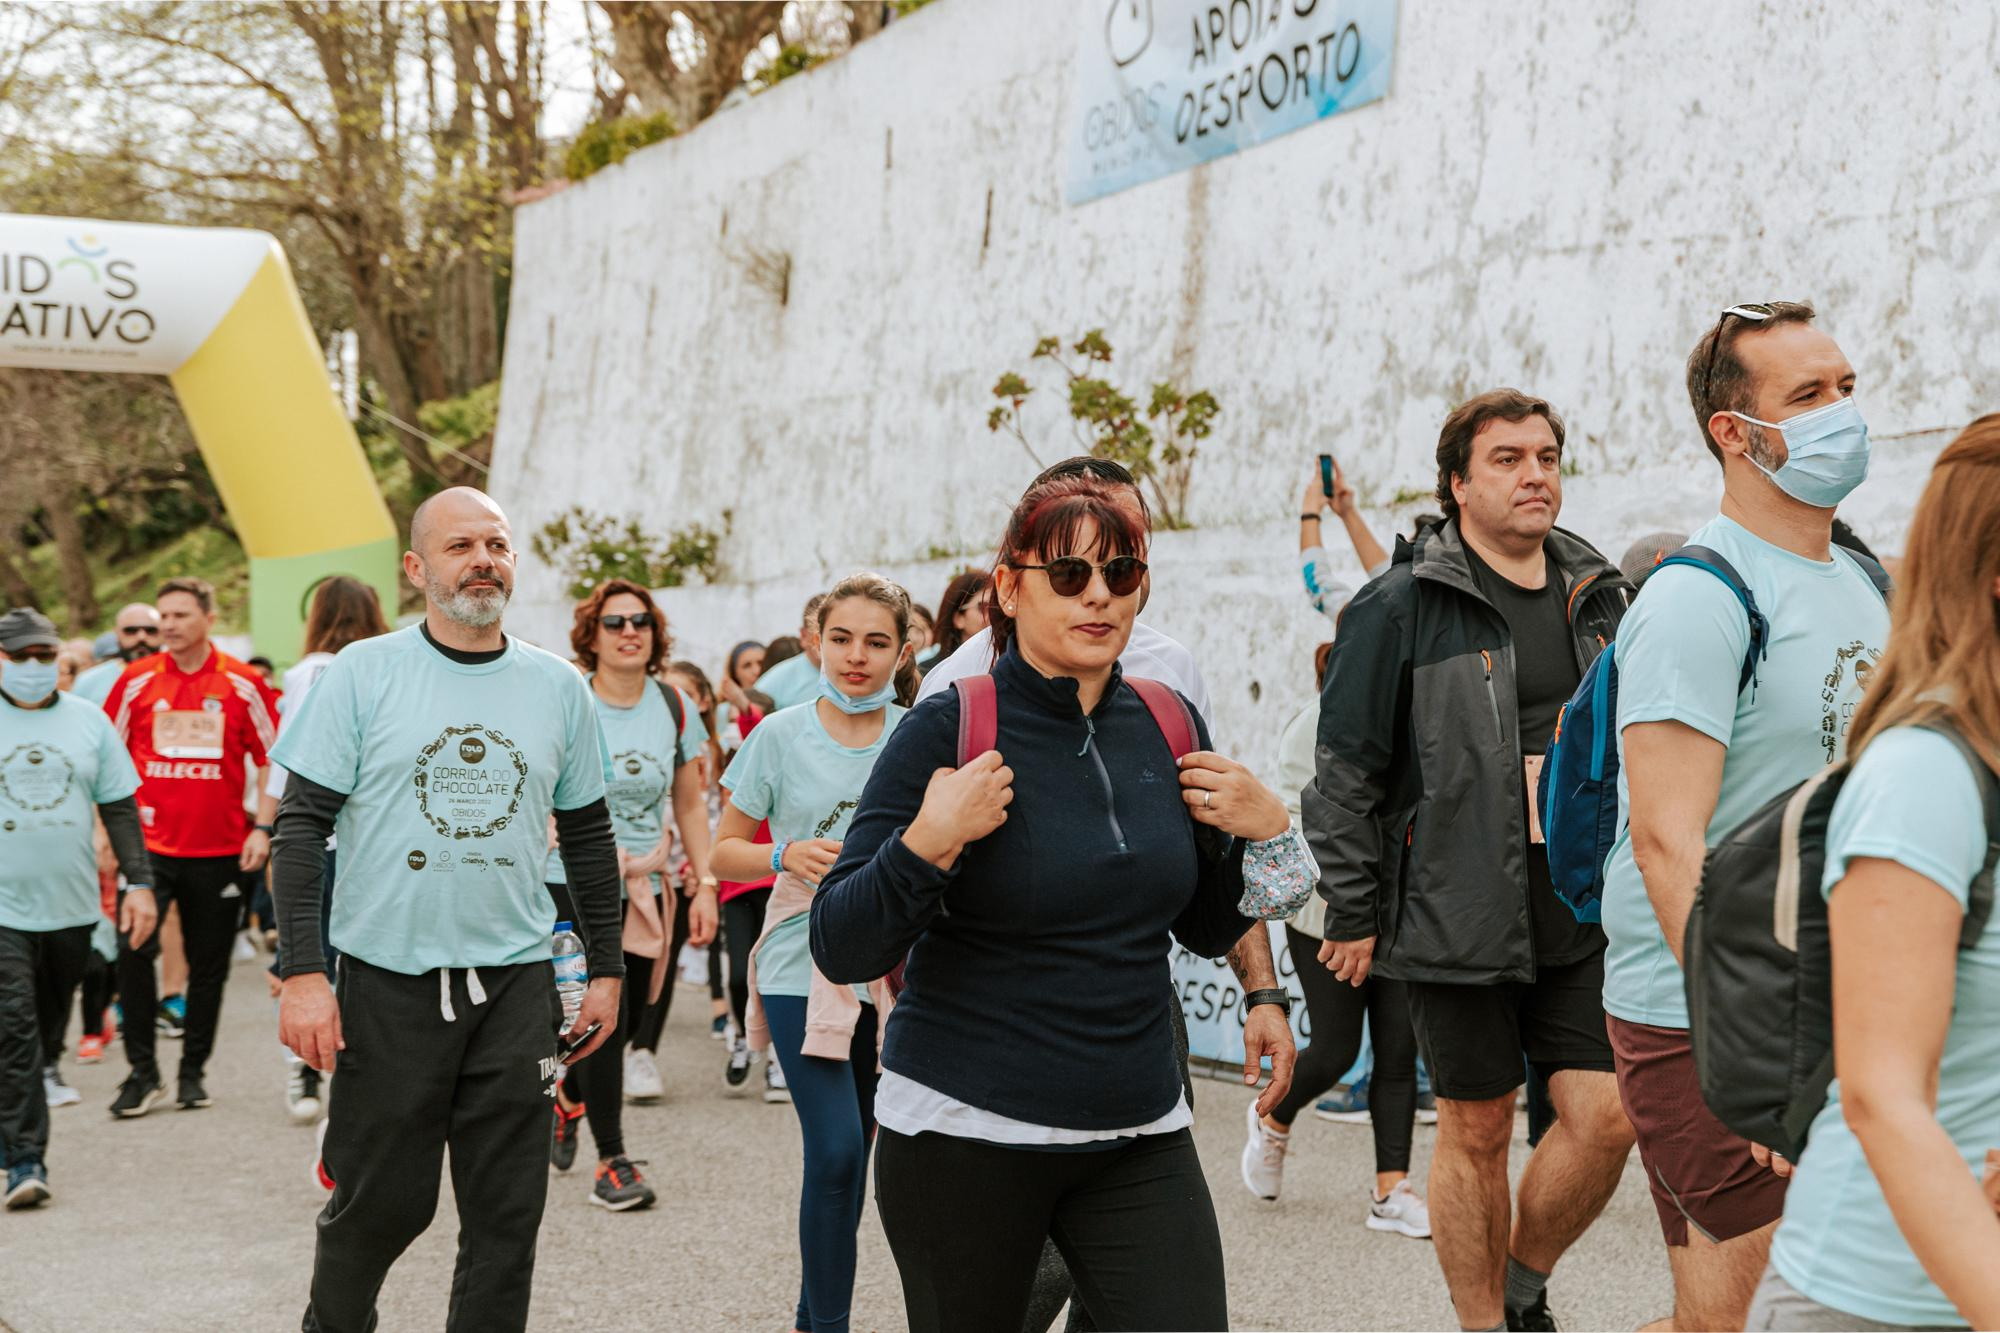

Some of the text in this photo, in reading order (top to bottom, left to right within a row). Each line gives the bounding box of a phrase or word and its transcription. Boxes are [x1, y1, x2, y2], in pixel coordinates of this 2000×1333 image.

[1173, 22, 1361, 144] DESPORTO
[433, 766, 511, 782] CORRIDA DO
[432, 781, 509, 795] CHOCOLATE
